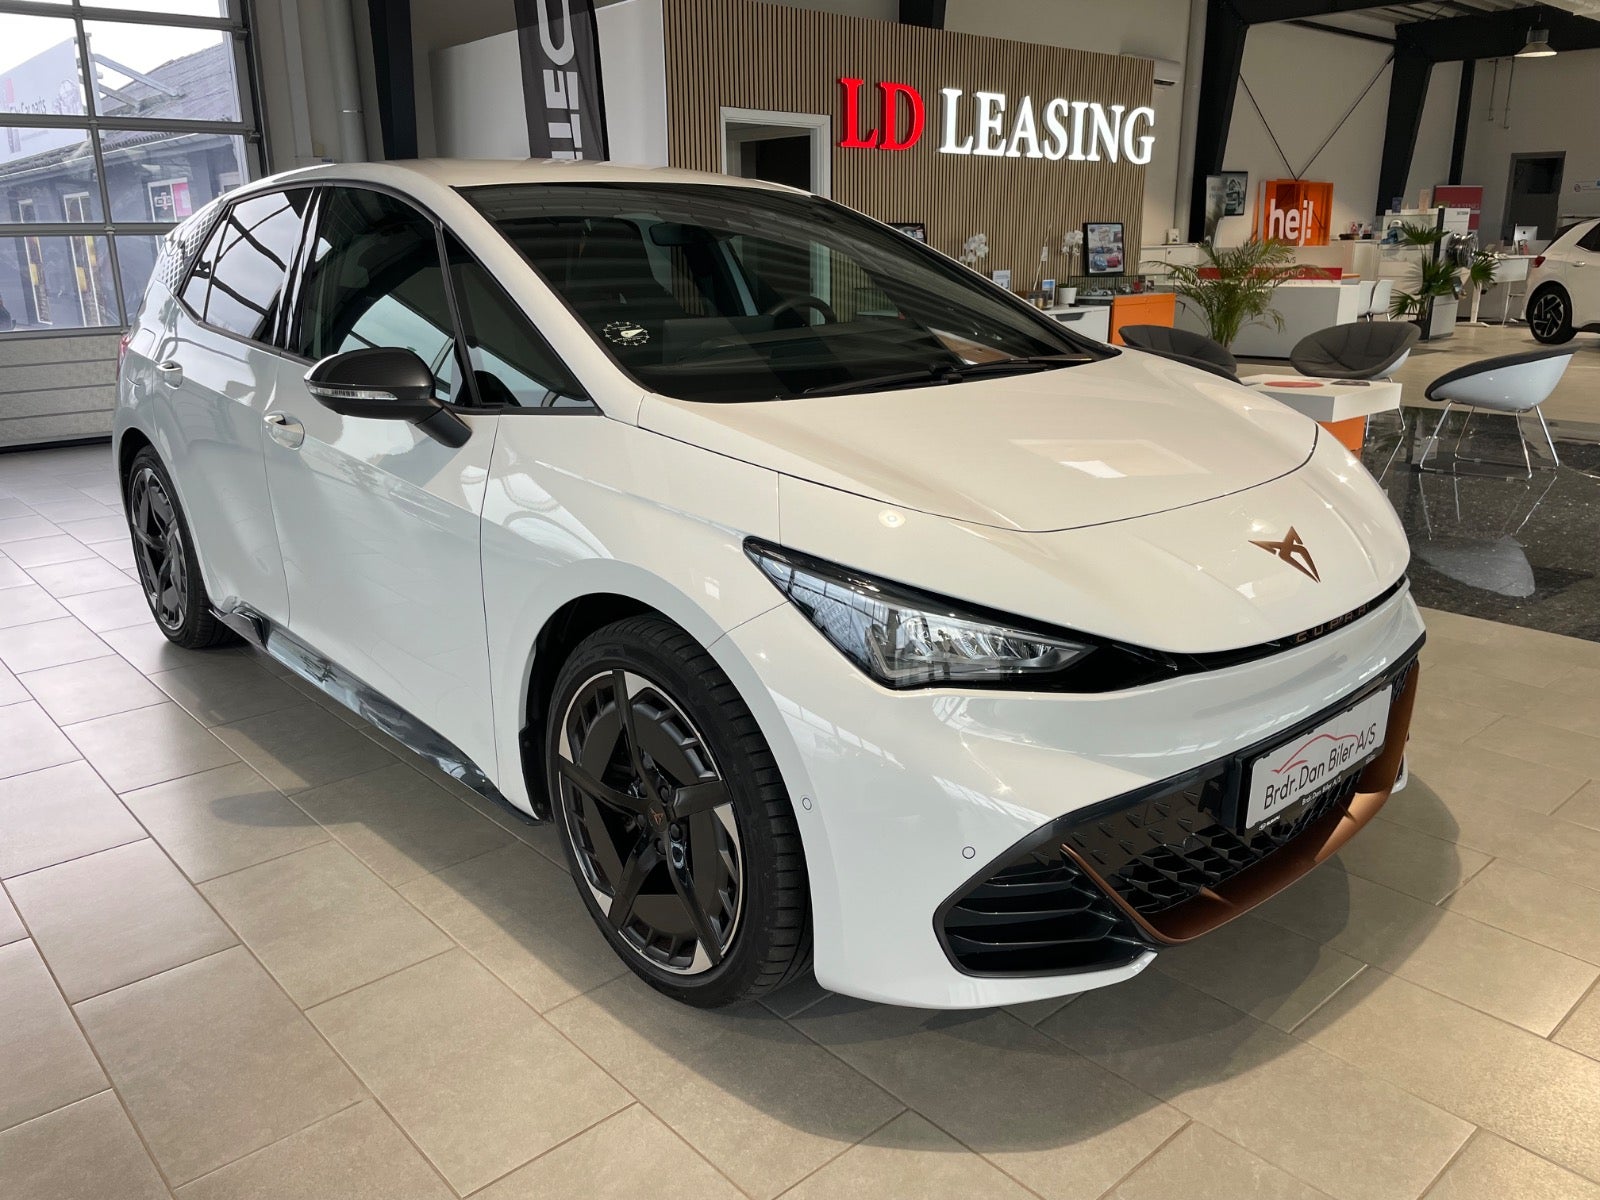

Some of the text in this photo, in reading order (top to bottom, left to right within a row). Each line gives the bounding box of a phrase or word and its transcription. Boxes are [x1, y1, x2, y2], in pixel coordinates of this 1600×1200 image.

[838, 77, 1155, 165] LD LEASING
[1268, 198, 1314, 247] hej!
[1296, 604, 1366, 643] CUPRA
[1328, 743, 1355, 772] Biler
[1355, 723, 1377, 754] A/S
